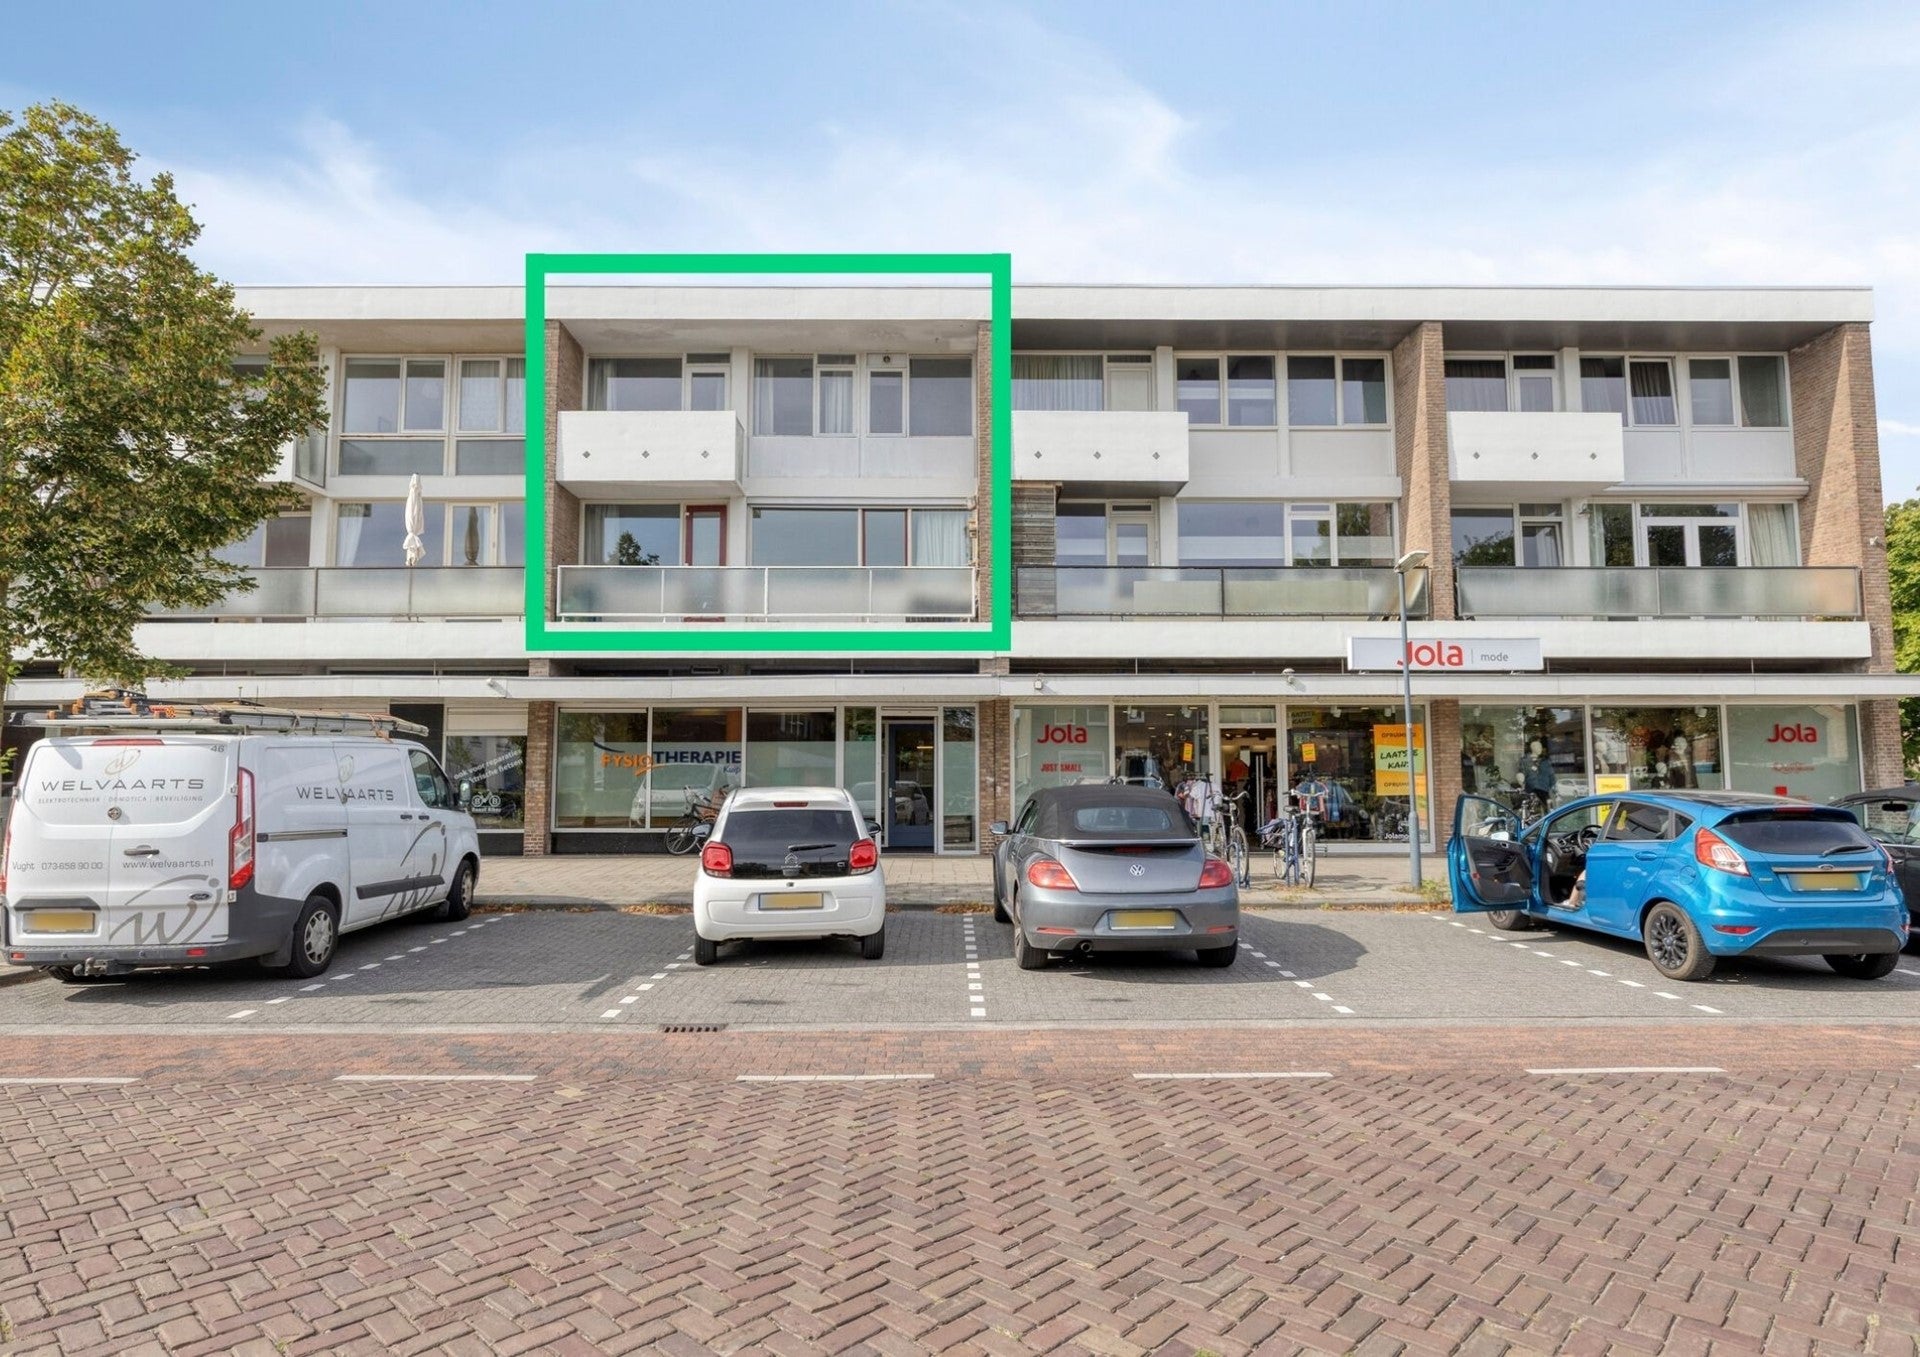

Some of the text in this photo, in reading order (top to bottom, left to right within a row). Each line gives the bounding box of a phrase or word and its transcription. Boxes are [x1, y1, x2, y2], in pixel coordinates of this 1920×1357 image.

[1396, 640, 1509, 667] Jola mode
[1036, 723, 1088, 744] Jola
[1766, 723, 1818, 743] Jola
[210, 744, 225, 753] 46
[1379, 748, 1419, 760] LAATSE
[41, 778, 205, 792] WELVAARTS
[295, 786, 395, 801] WELVAARTS
[12, 861, 36, 872] Vught
[122, 858, 214, 869] www.welvaarts.nl
